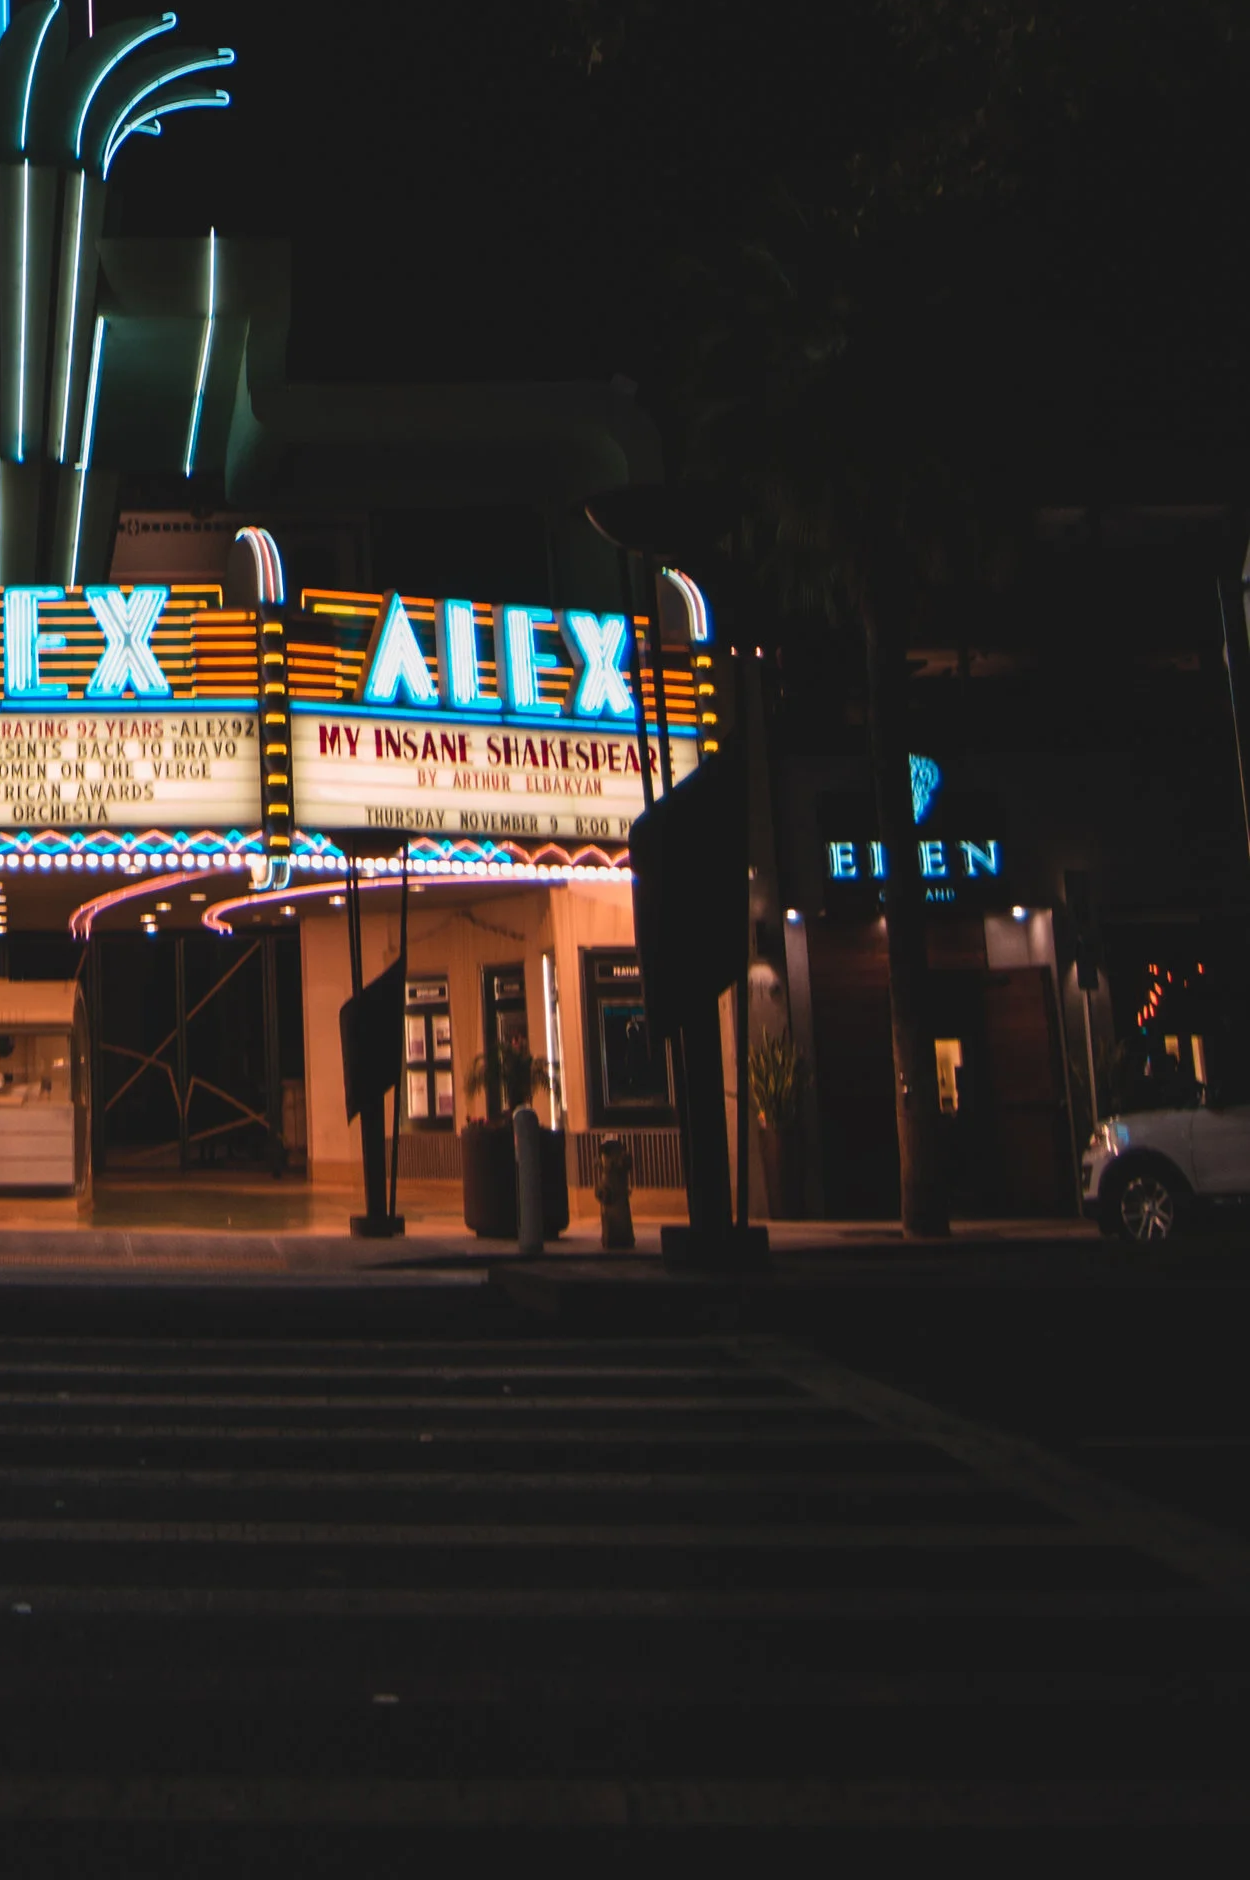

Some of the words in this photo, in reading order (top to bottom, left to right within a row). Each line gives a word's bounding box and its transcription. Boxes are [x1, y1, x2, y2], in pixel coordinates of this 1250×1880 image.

[361, 591, 637, 718] ALEX
[77, 720, 97, 738] 92
[106, 720, 165, 738] YEARS
[77, 741, 127, 759] BACK
[140, 741, 162, 759] TO
[173, 741, 237, 759] BRAVO
[318, 723, 361, 758] MY
[374, 726, 473, 766] INSANE
[60, 762, 85, 780] ON
[101, 762, 135, 780] THE
[153, 762, 212, 780] VERGE
[76, 783, 154, 802] AWARDS
[417, 768, 438, 788] BY
[453, 770, 511, 792] ARTHUR
[526, 773, 603, 796] ELBAKYAN
[12, 802, 109, 823] ORCHESTA
[365, 806, 445, 829] THURSDAY
[460, 810, 539, 834] NOVEMBER
[549, 814, 559, 834] 9
[575, 816, 610, 836] 8:00
